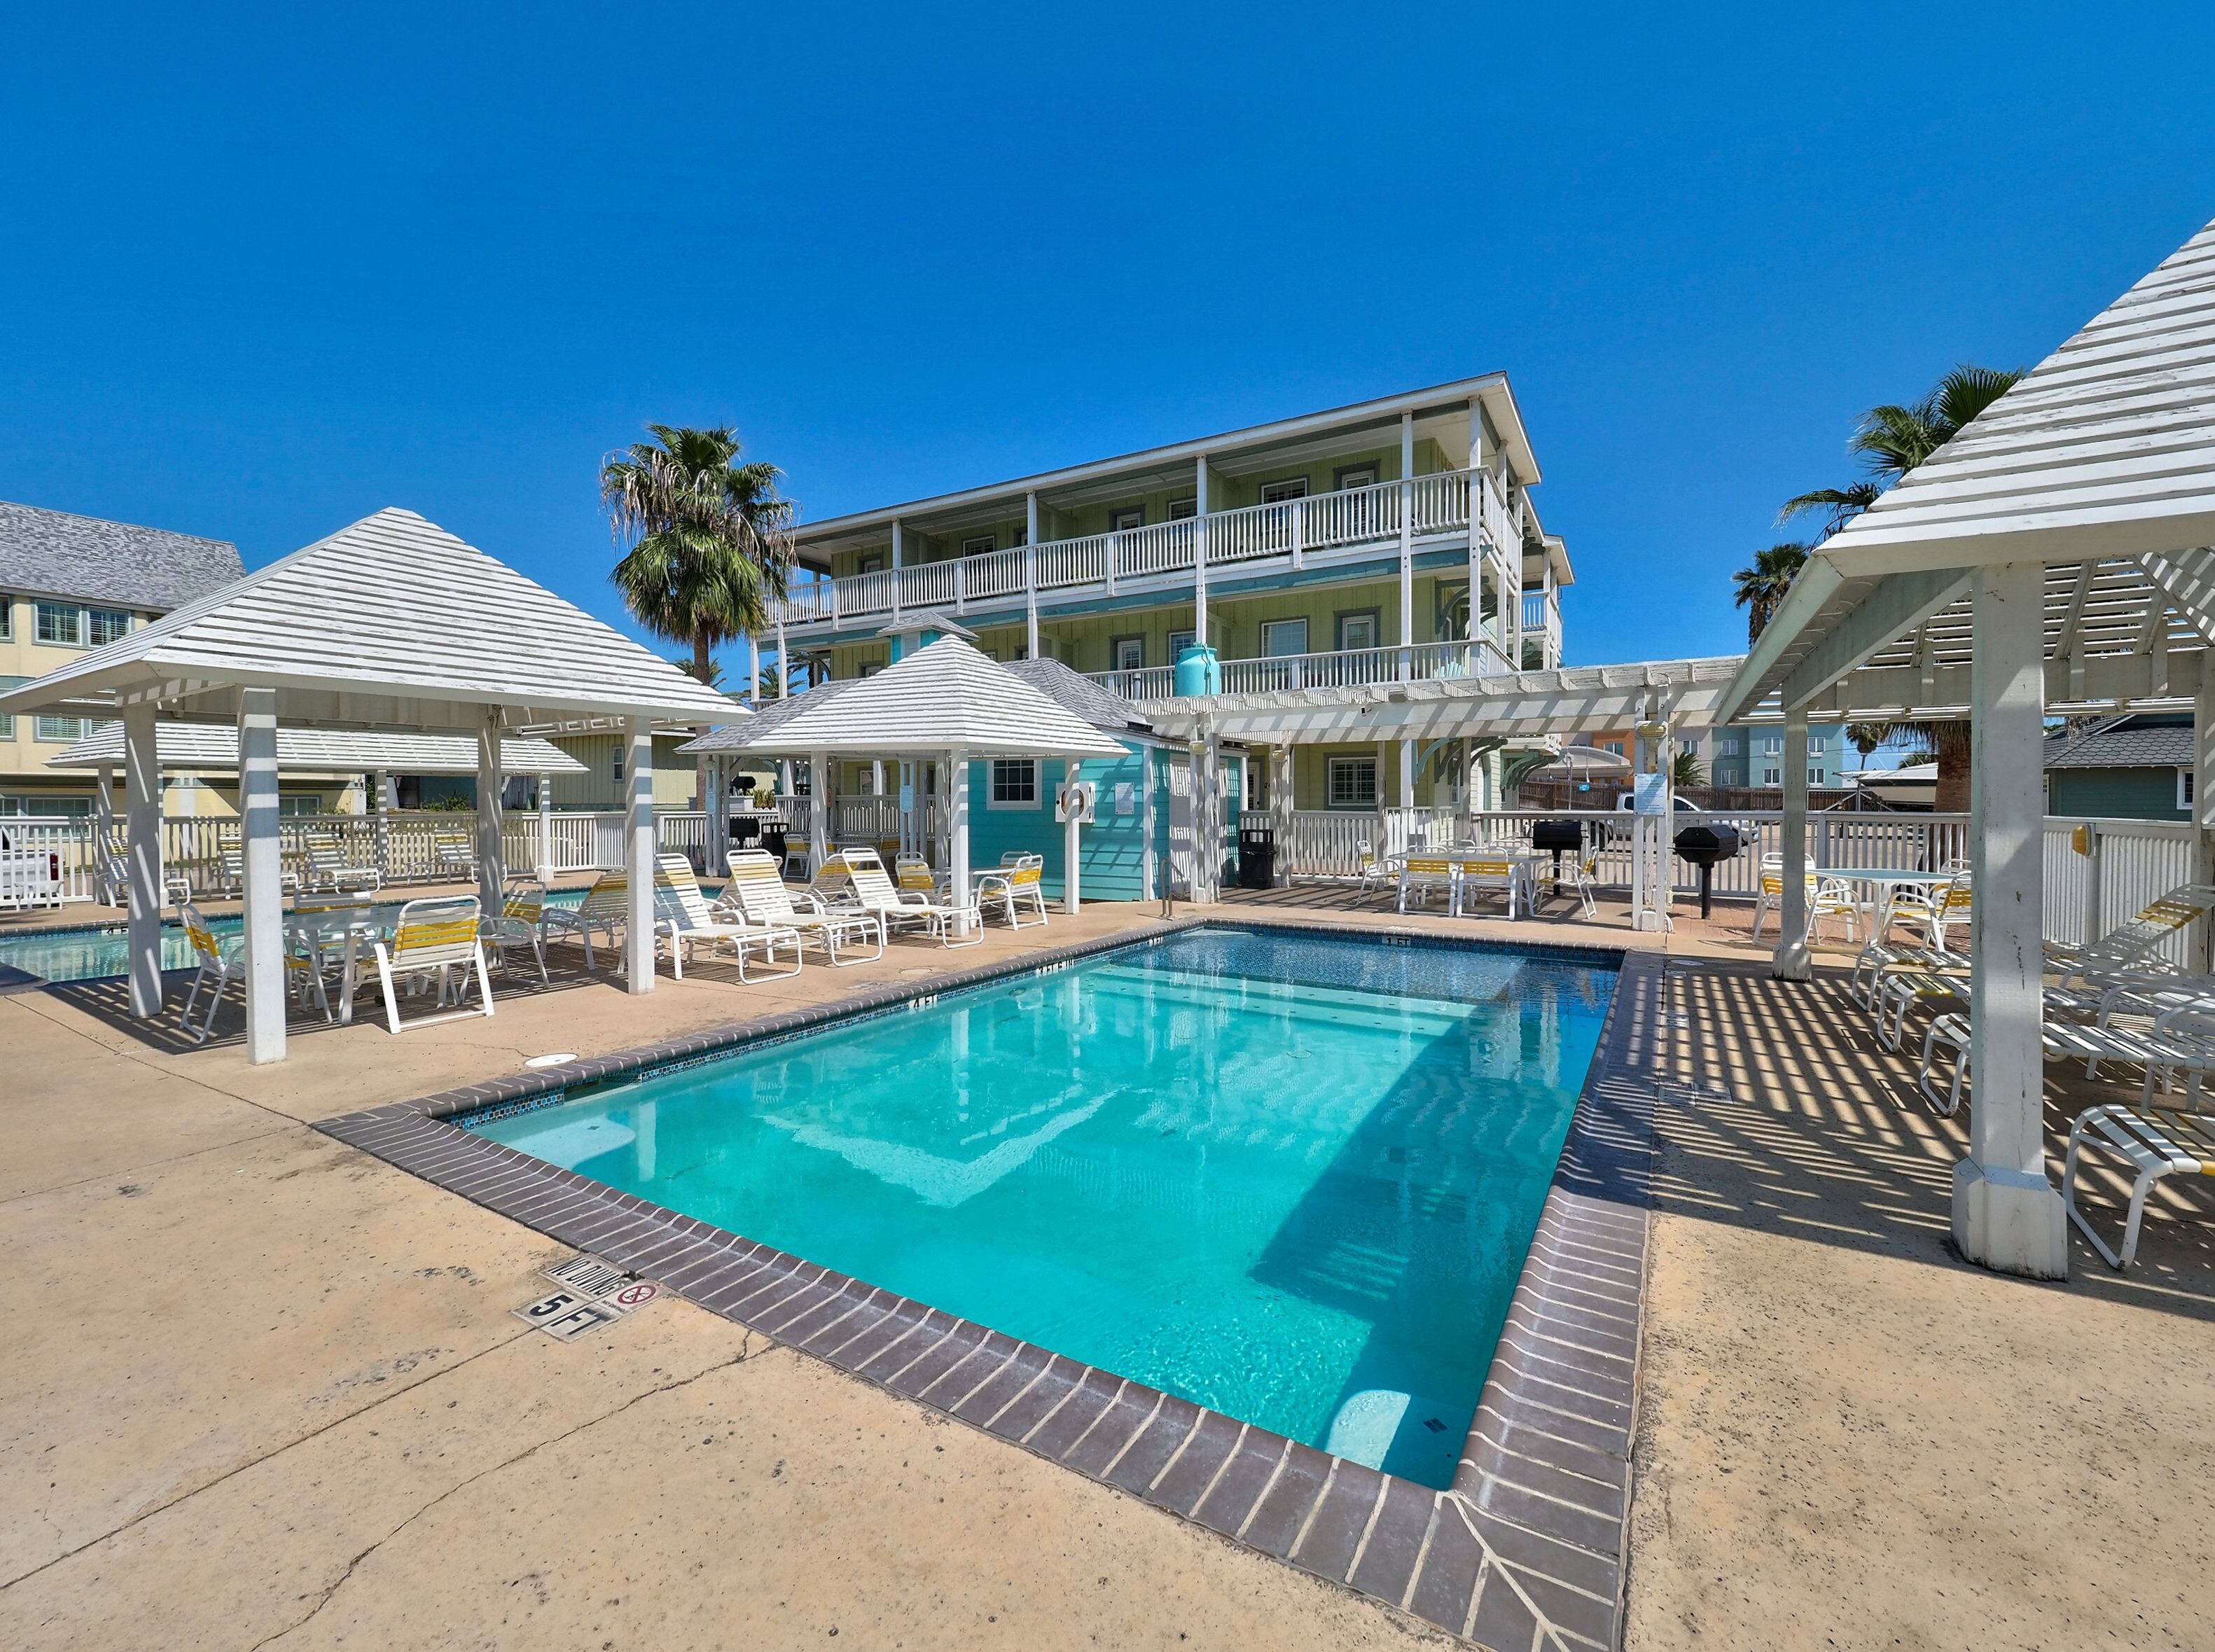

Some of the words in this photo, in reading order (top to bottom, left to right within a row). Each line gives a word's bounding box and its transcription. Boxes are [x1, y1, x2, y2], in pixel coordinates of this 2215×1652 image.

[1046, 962, 1055, 972] FT
[924, 993, 936, 1006] FT
[548, 1257, 592, 1277] NO
[565, 1265, 621, 1296] DIVING
[529, 1294, 575, 1317] 5
[550, 1307, 613, 1335] FT
